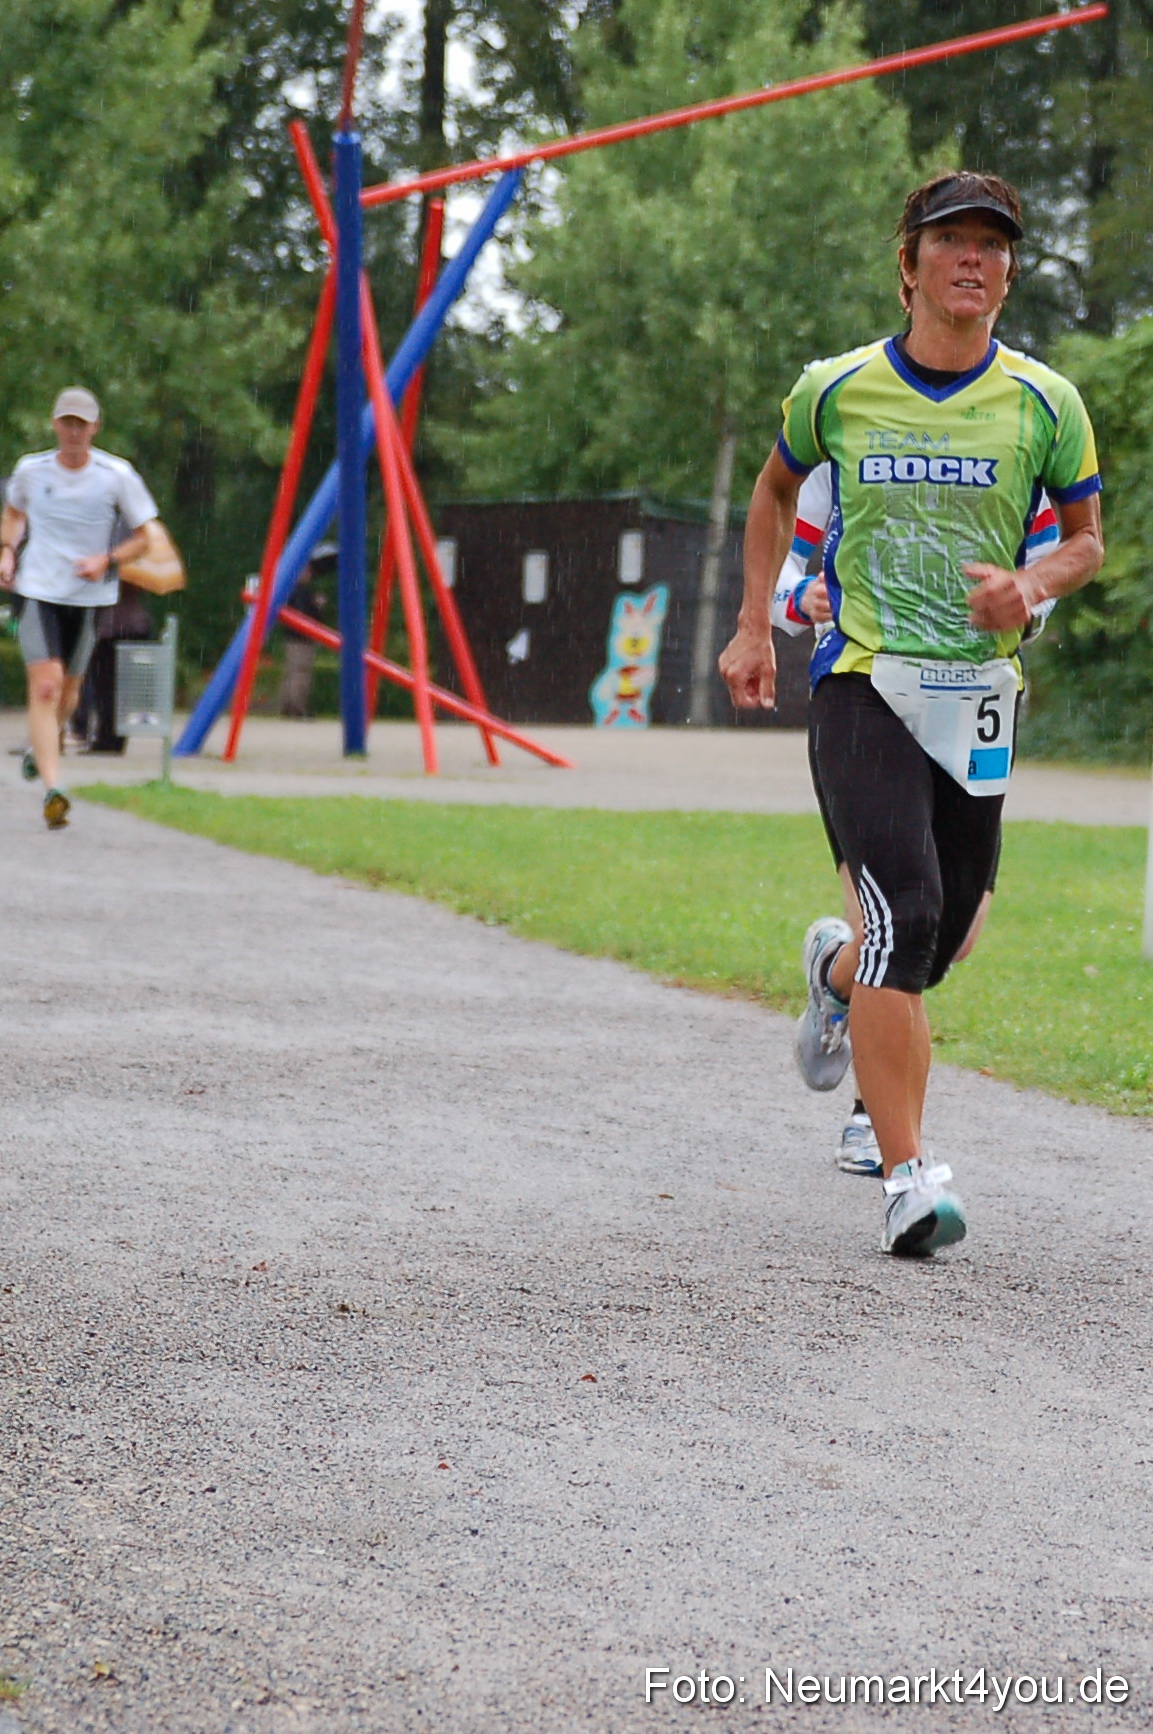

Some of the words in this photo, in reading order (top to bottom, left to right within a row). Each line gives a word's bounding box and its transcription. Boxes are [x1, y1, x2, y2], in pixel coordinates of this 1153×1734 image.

[864, 430, 950, 451] TEAM
[860, 455, 998, 487] BOCK
[921, 668, 977, 682] BOCK
[977, 694, 1000, 743] 5
